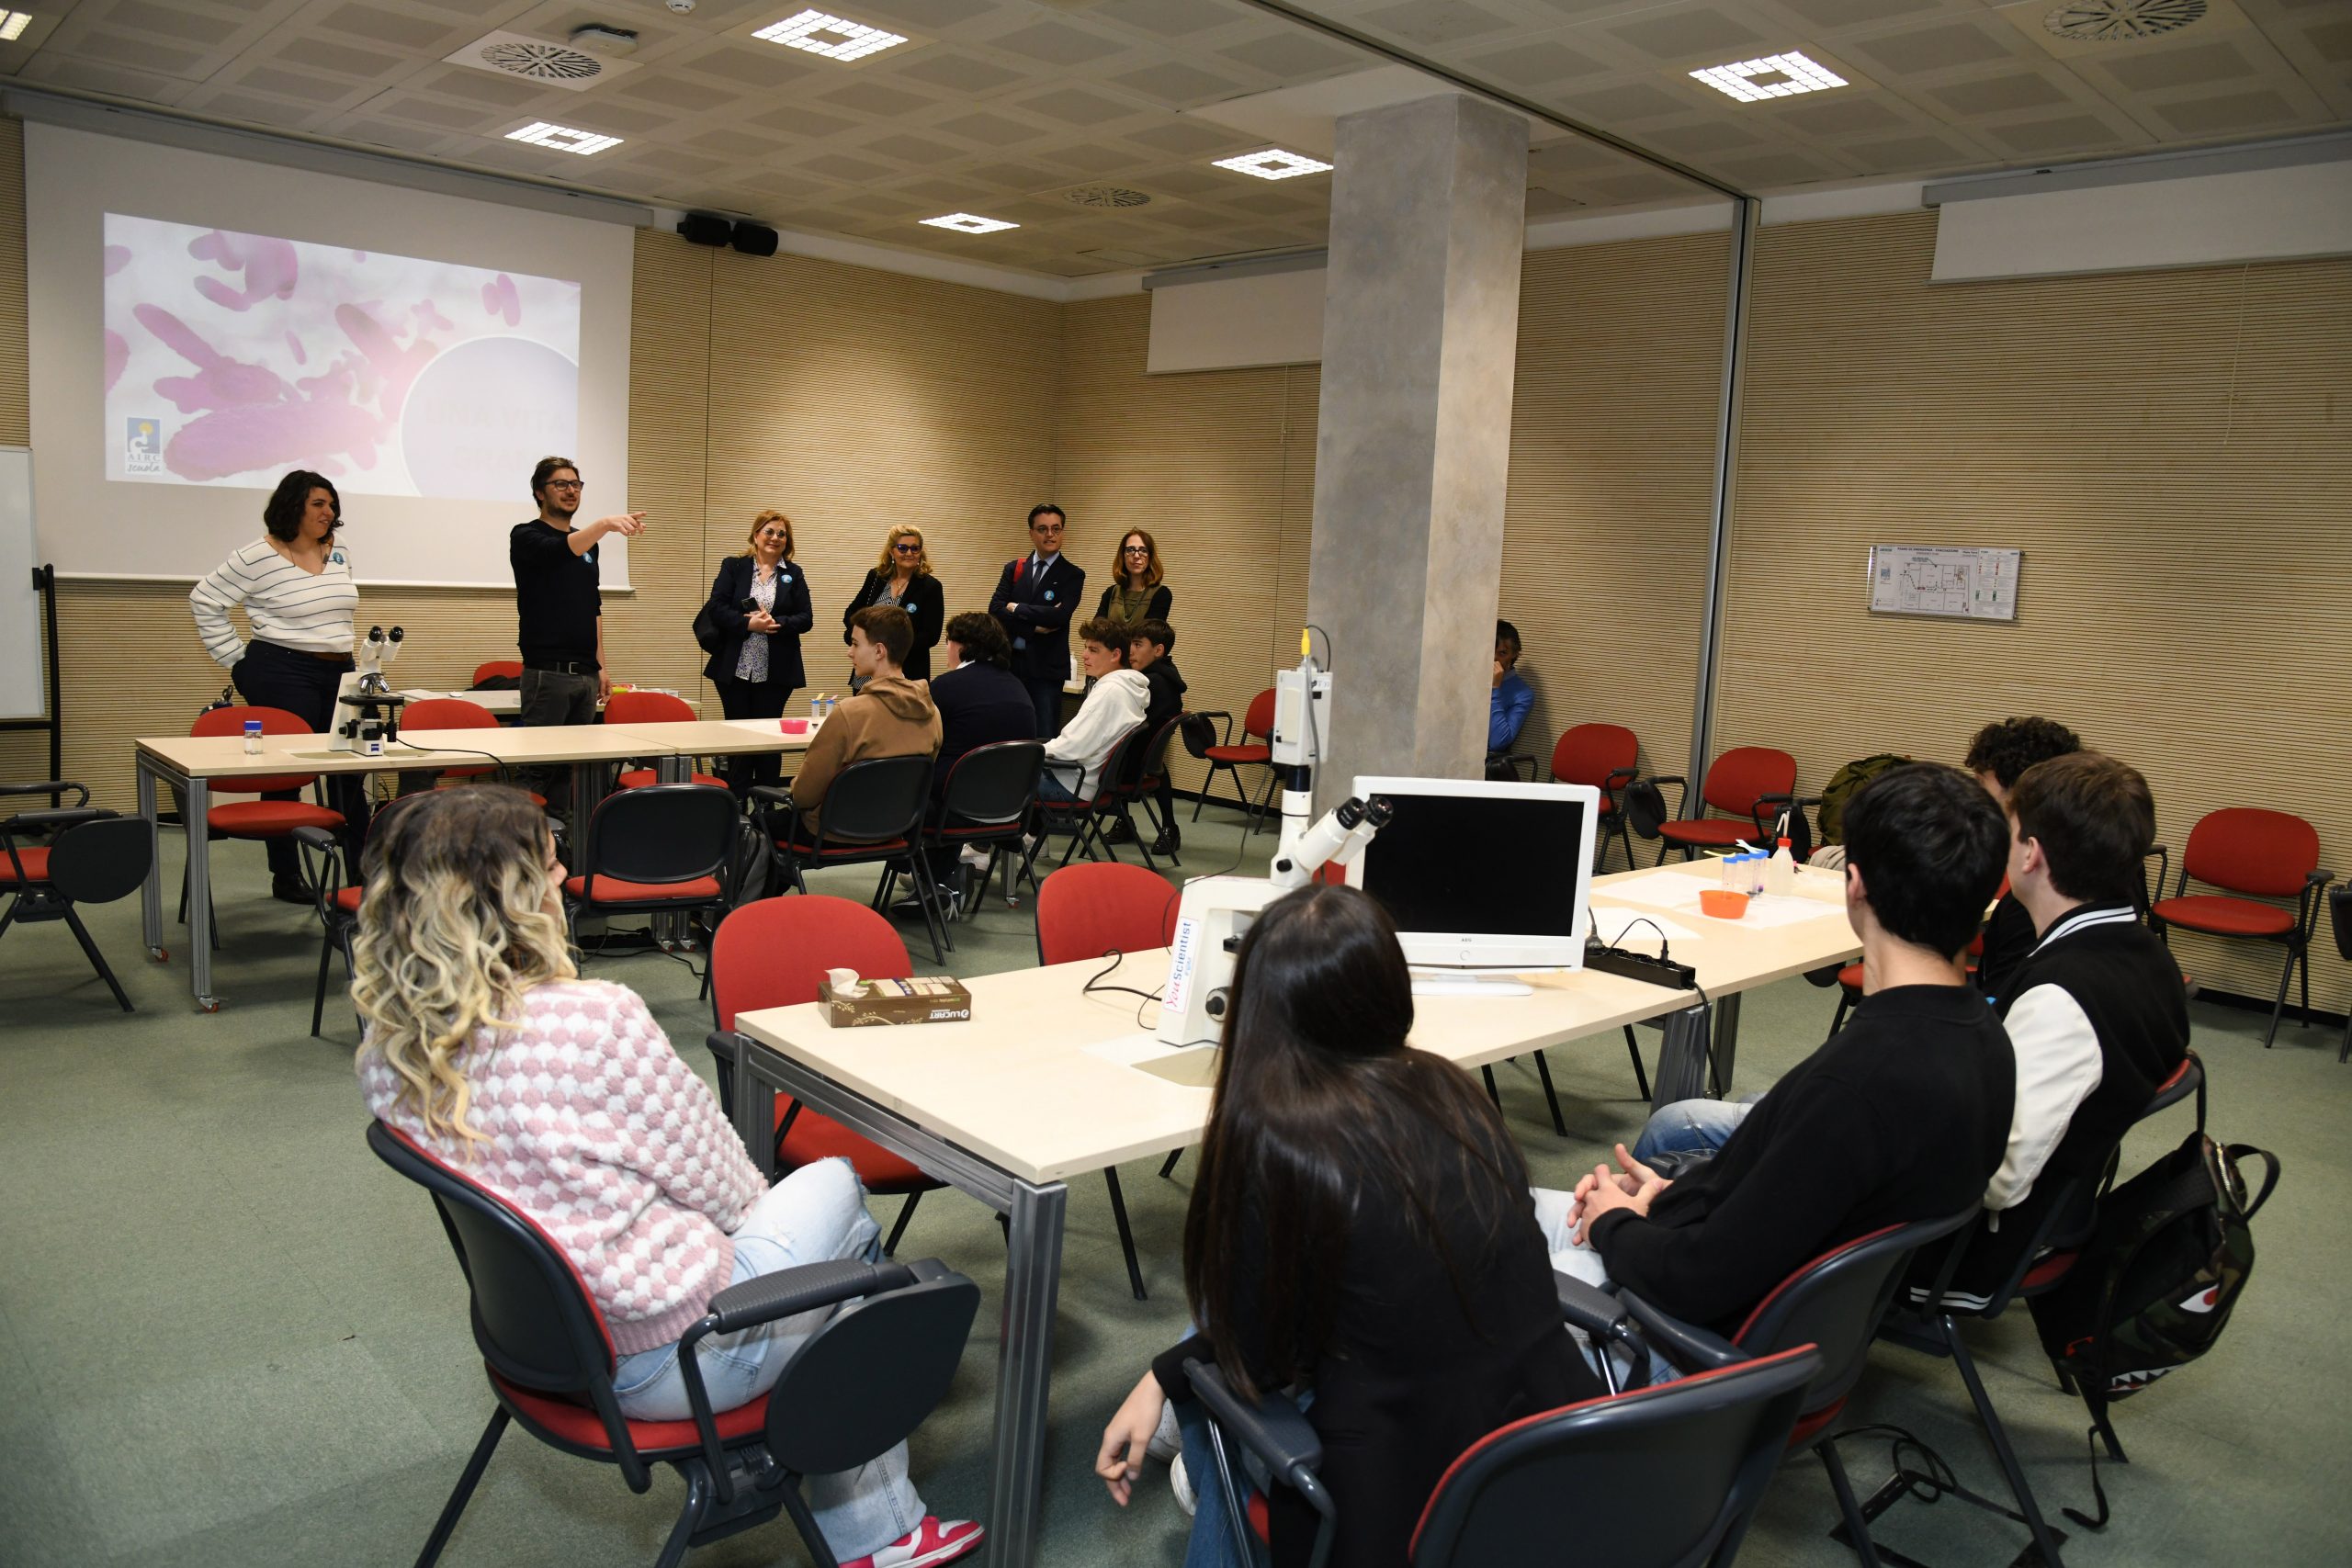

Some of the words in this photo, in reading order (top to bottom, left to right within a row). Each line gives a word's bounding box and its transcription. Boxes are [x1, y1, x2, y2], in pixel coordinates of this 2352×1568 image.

[426, 397, 492, 428] UNA
[501, 405, 565, 434] VITA
[128, 454, 161, 462] AIRC
[127, 462, 161, 472] scuola
[1166, 921, 1191, 1008] YouScientist
[929, 1010, 961, 1020] LUCART
